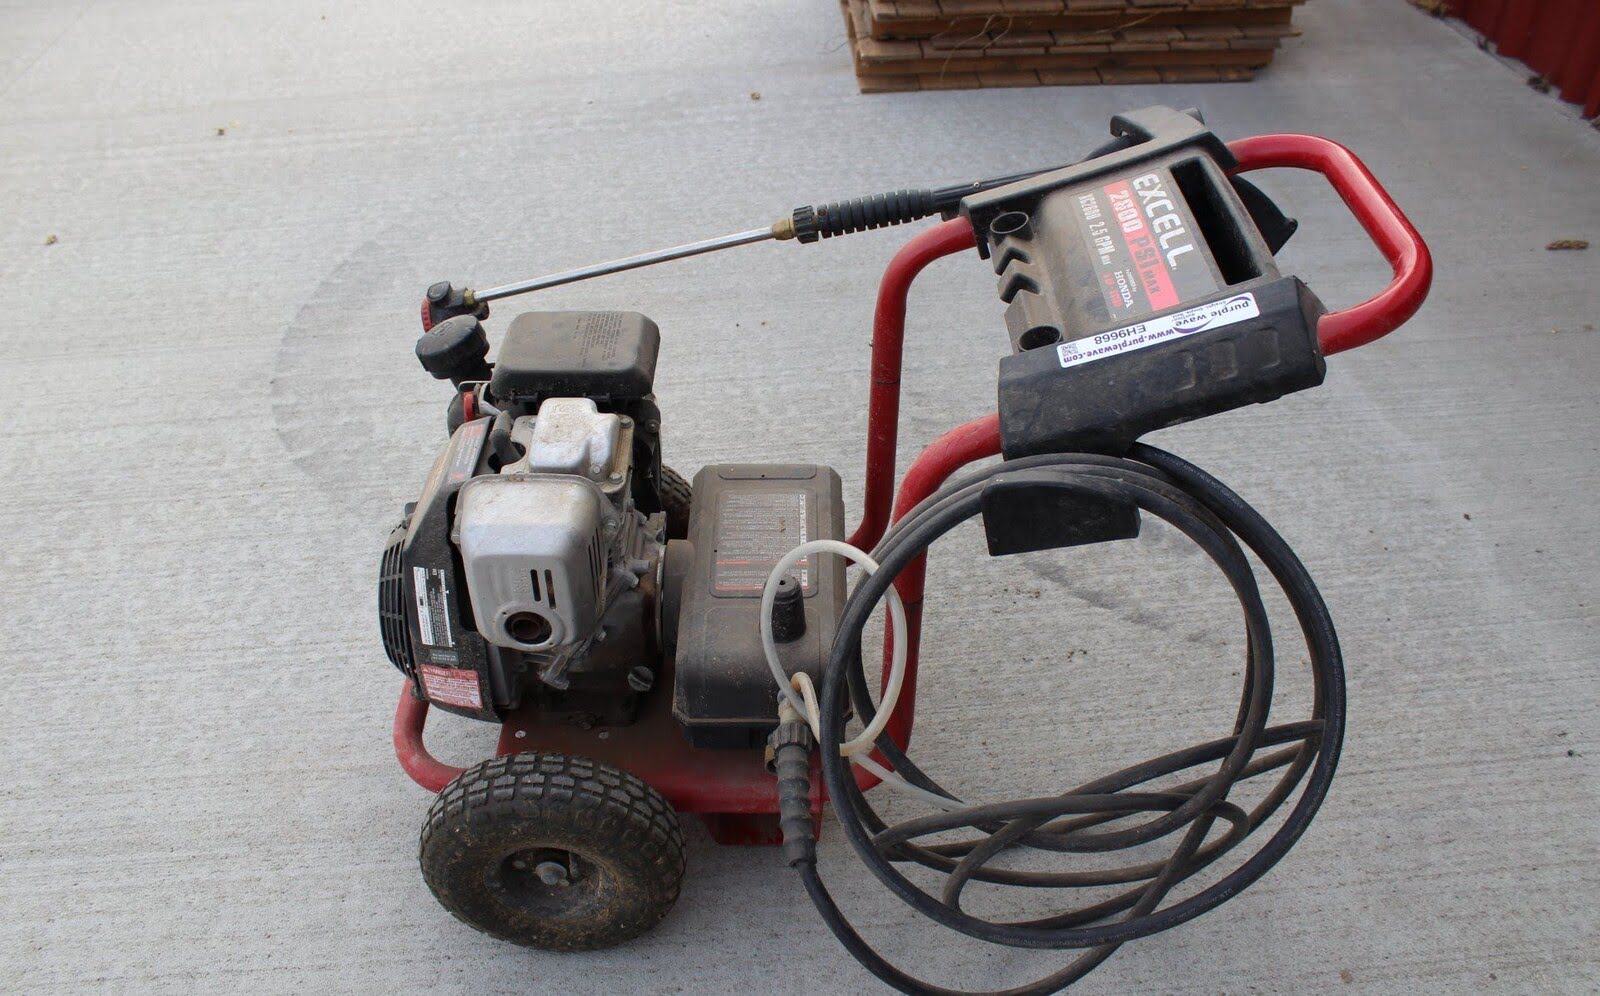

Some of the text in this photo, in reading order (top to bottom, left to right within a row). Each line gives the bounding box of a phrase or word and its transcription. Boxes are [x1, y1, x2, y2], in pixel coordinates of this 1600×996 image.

[1133, 174, 1194, 268] EXCELL
[1095, 236, 1115, 255] GPM
[1131, 236, 1159, 268] PSI
[1114, 270, 1134, 308] HONDA
[1143, 270, 1161, 294] MAX
[1175, 314, 1207, 327] wave
[1210, 301, 1249, 316] purple
[1063, 328, 1174, 363] www.purplewave.com
[1094, 324, 1146, 345] EH9668
